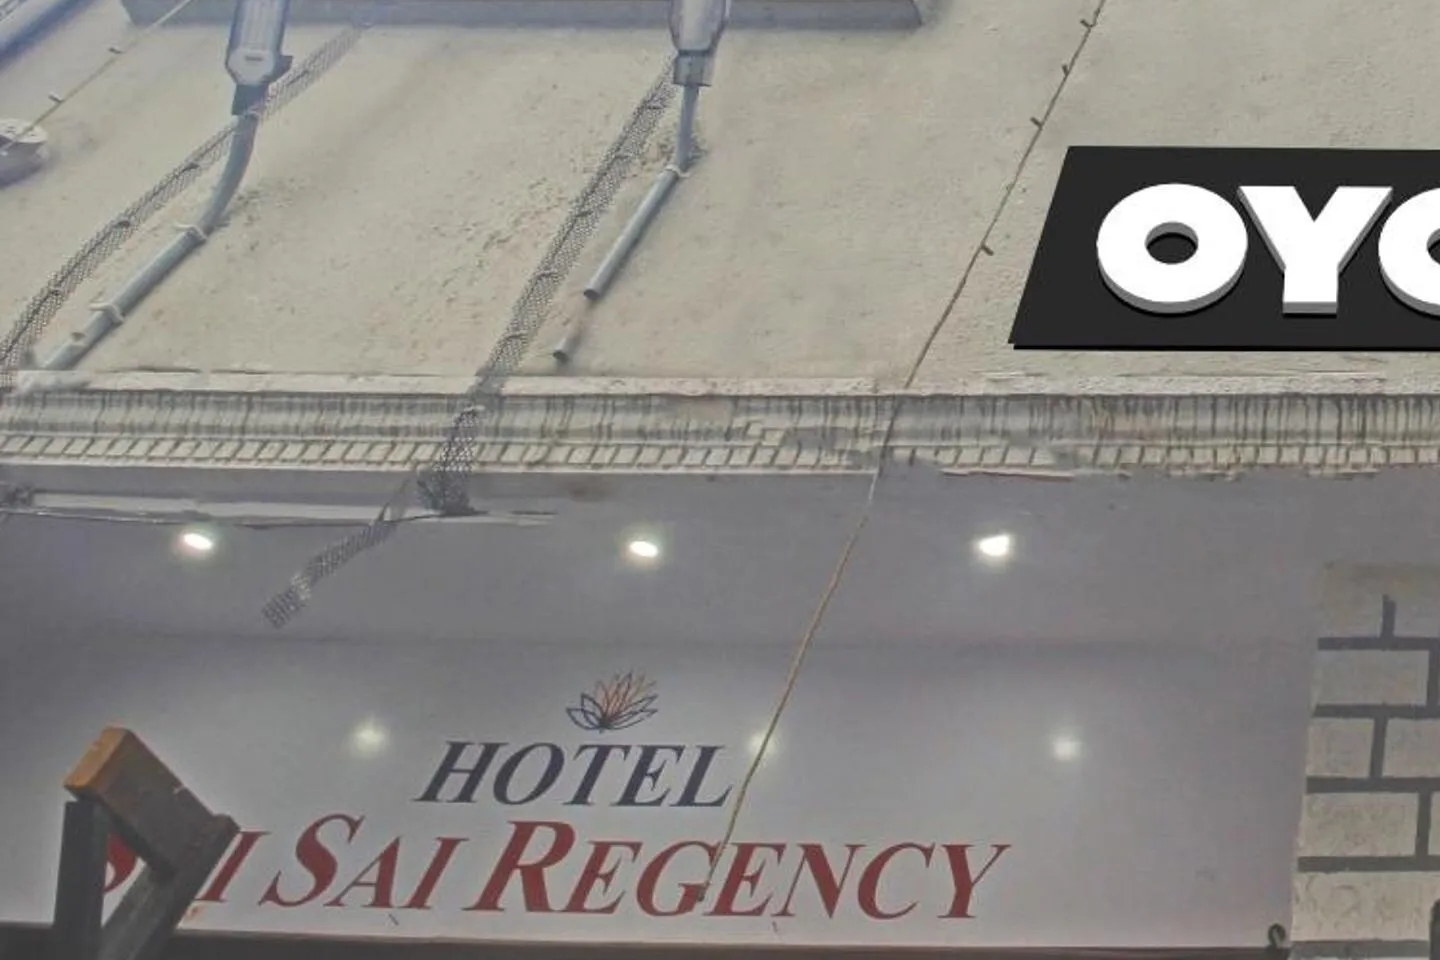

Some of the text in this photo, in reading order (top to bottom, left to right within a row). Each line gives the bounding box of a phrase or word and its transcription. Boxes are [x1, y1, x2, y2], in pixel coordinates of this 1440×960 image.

[412, 741, 733, 807] HOTEL
[258, 813, 471, 908] SAI
[462, 820, 1012, 920] REGENCY
